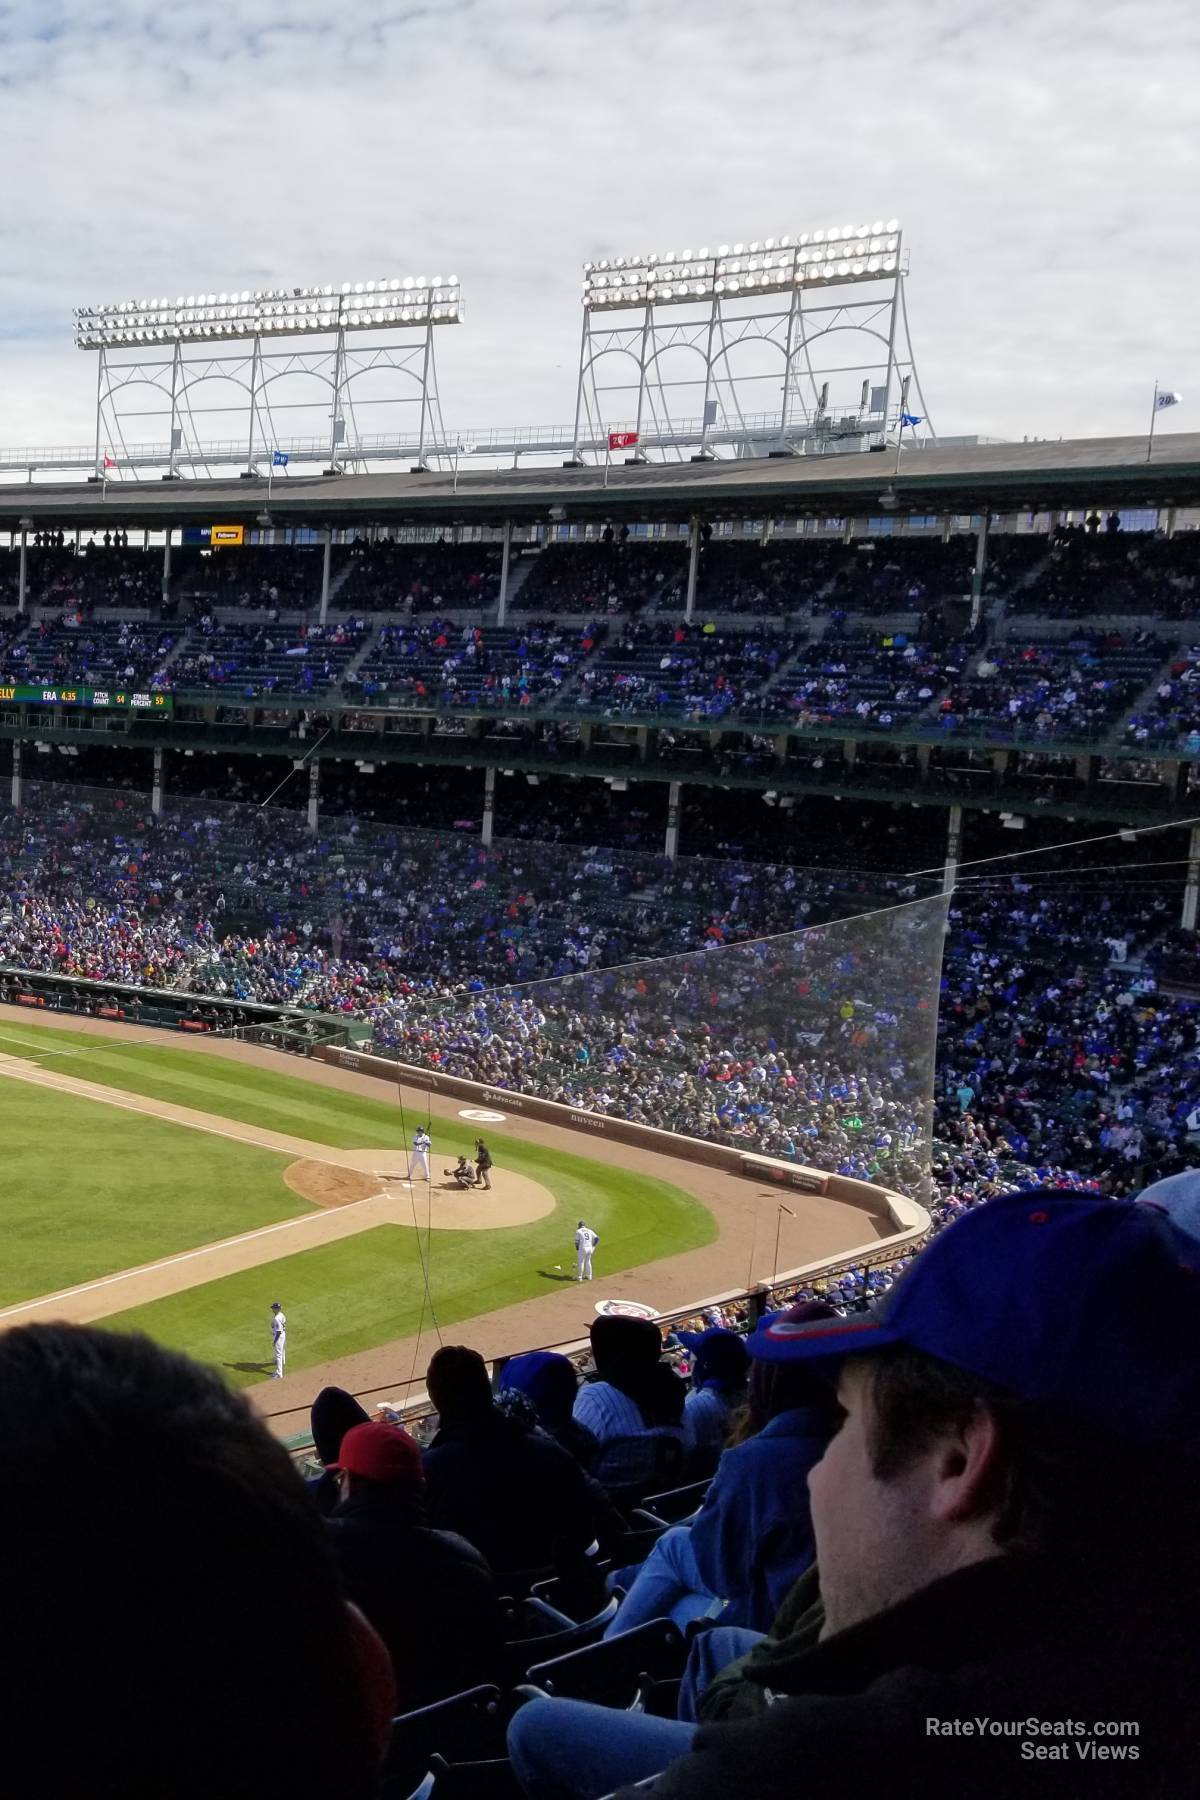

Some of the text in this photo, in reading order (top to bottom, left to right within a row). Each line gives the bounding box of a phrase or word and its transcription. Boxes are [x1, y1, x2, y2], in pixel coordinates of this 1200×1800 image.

[43, 691, 76, 701] ERA 4.35
[492, 1094, 522, 1107] Advocate
[571, 1114, 604, 1128] nuveen
